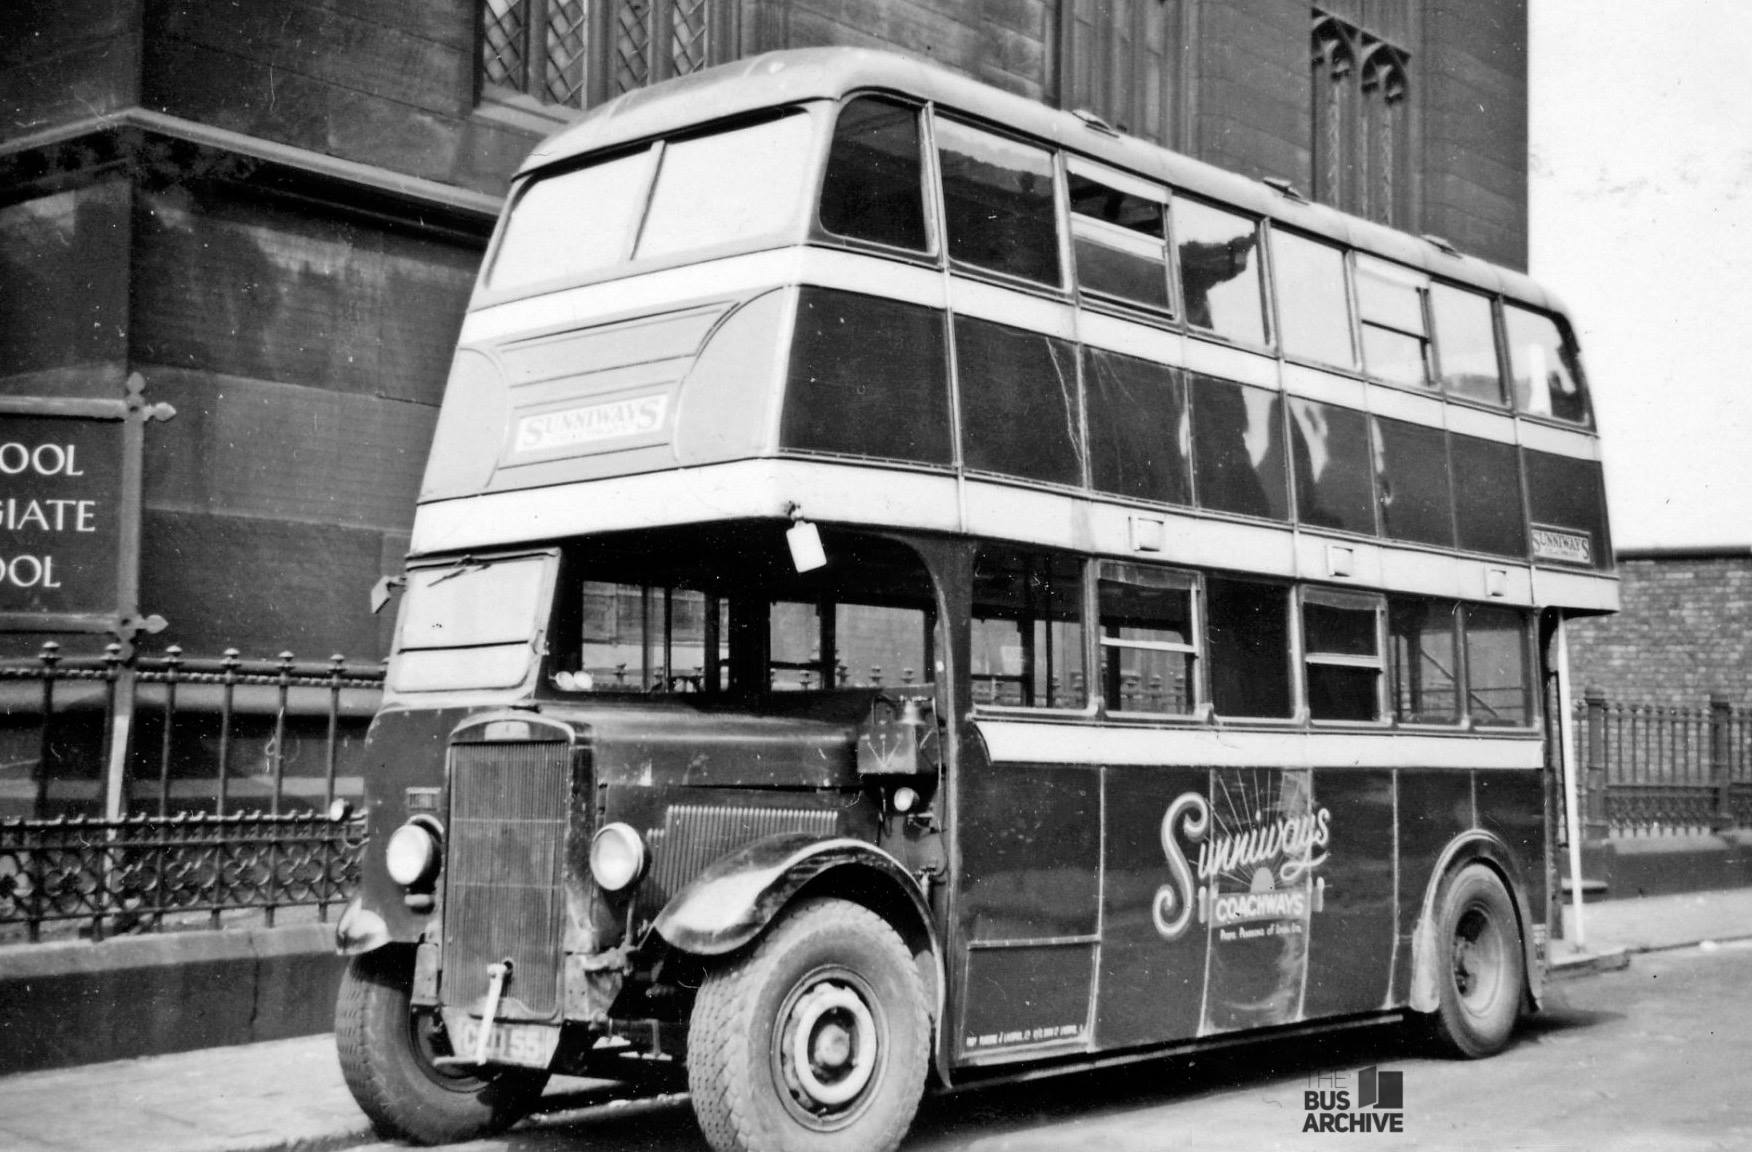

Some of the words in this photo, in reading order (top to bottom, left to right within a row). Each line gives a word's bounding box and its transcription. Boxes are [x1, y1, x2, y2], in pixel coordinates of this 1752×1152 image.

[0, 498, 96, 532] IATE
[0, 554, 61, 588] OL
[1152, 791, 1331, 939] Sunniways
[1215, 892, 1305, 922] COACHWAYS
